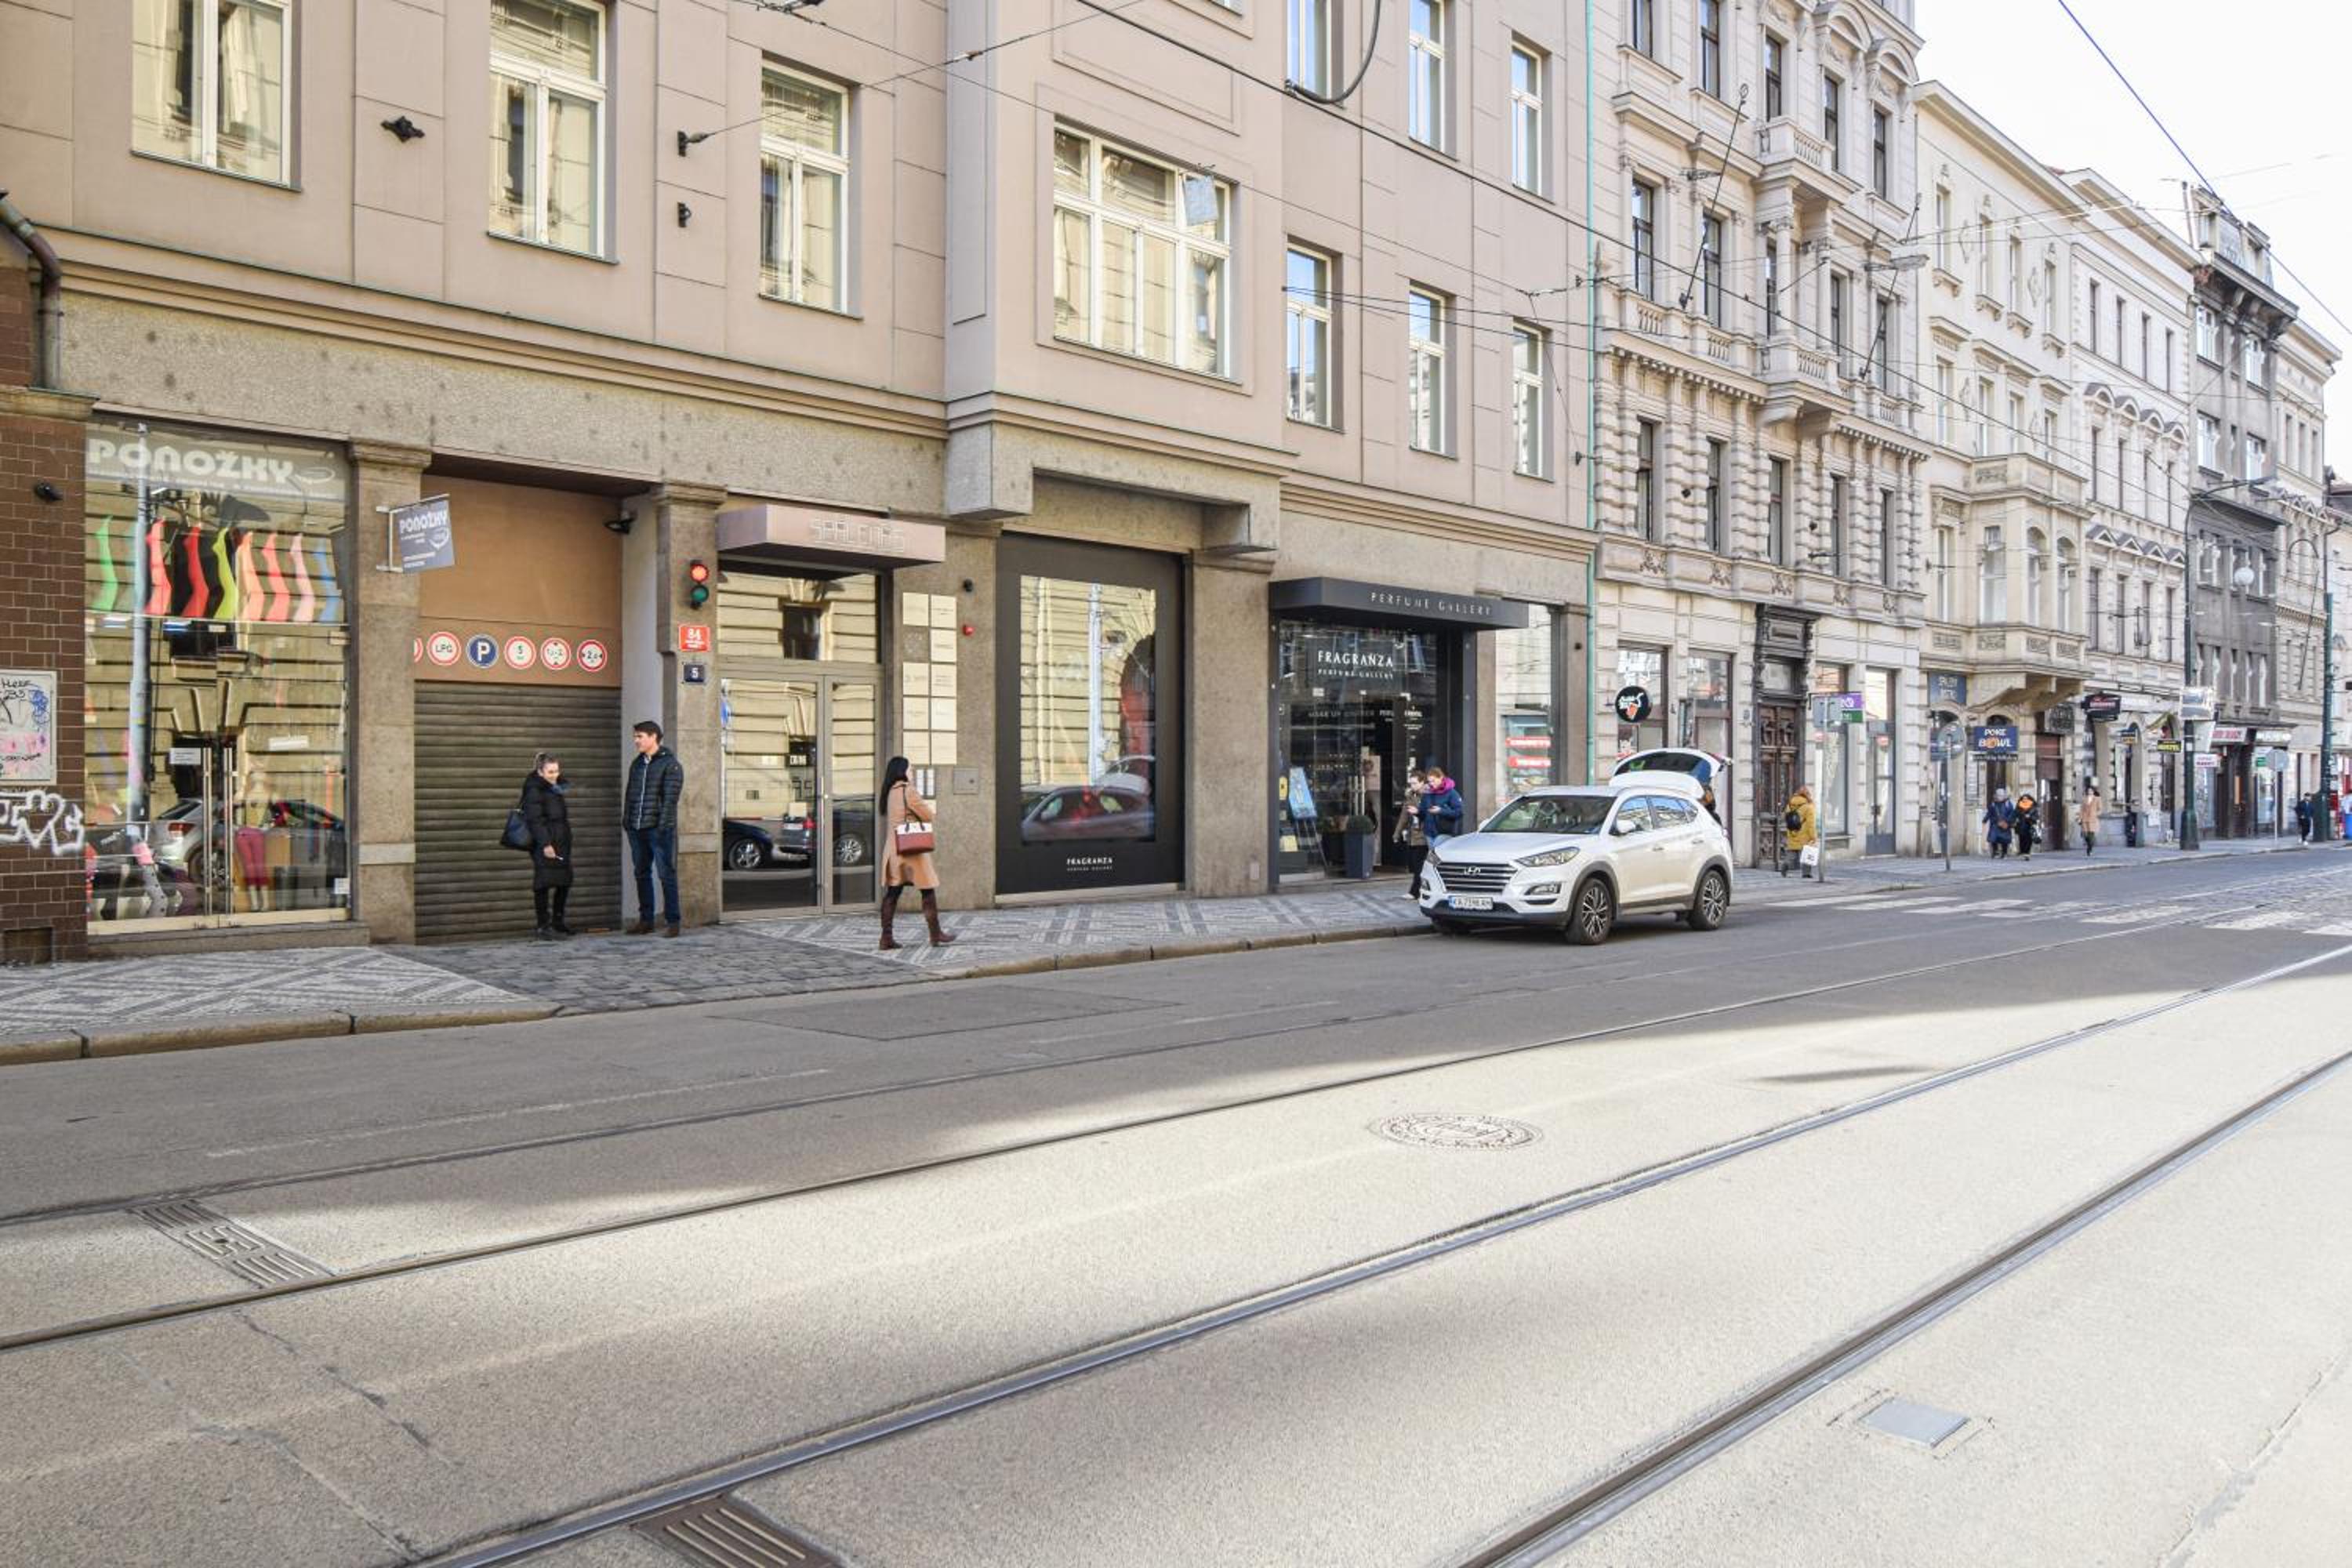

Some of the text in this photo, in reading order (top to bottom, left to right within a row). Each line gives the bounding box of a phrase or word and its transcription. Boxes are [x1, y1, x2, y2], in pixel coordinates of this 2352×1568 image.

[1371, 592, 1490, 615] PERFUME GALLERY
[477, 641, 490, 661] P
[1318, 650, 1393, 667] FRAGRANZA
